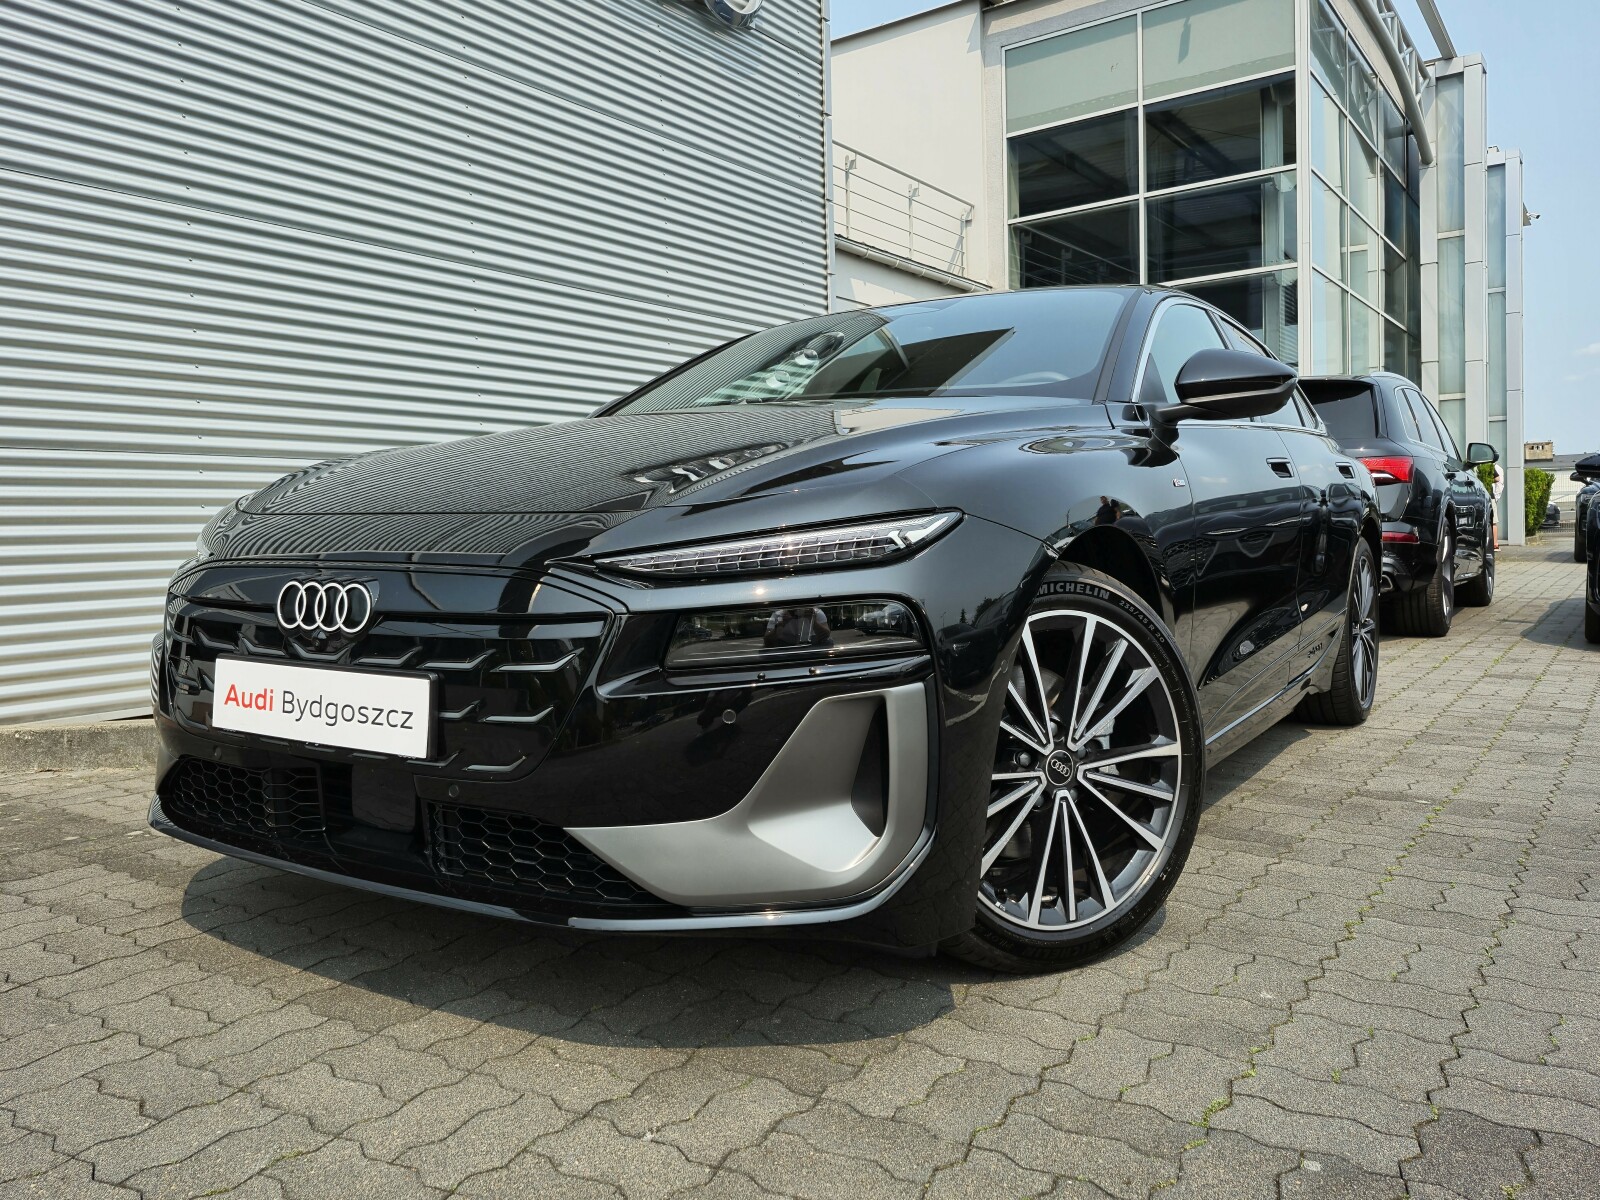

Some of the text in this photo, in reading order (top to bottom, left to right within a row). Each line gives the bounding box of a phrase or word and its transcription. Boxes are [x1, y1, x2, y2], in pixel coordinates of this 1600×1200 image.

[1038, 582, 1110, 600] MICHELIN
[1155, 632, 1165, 643] 20
[224, 684, 414, 730] Audi Bydgoszcz
